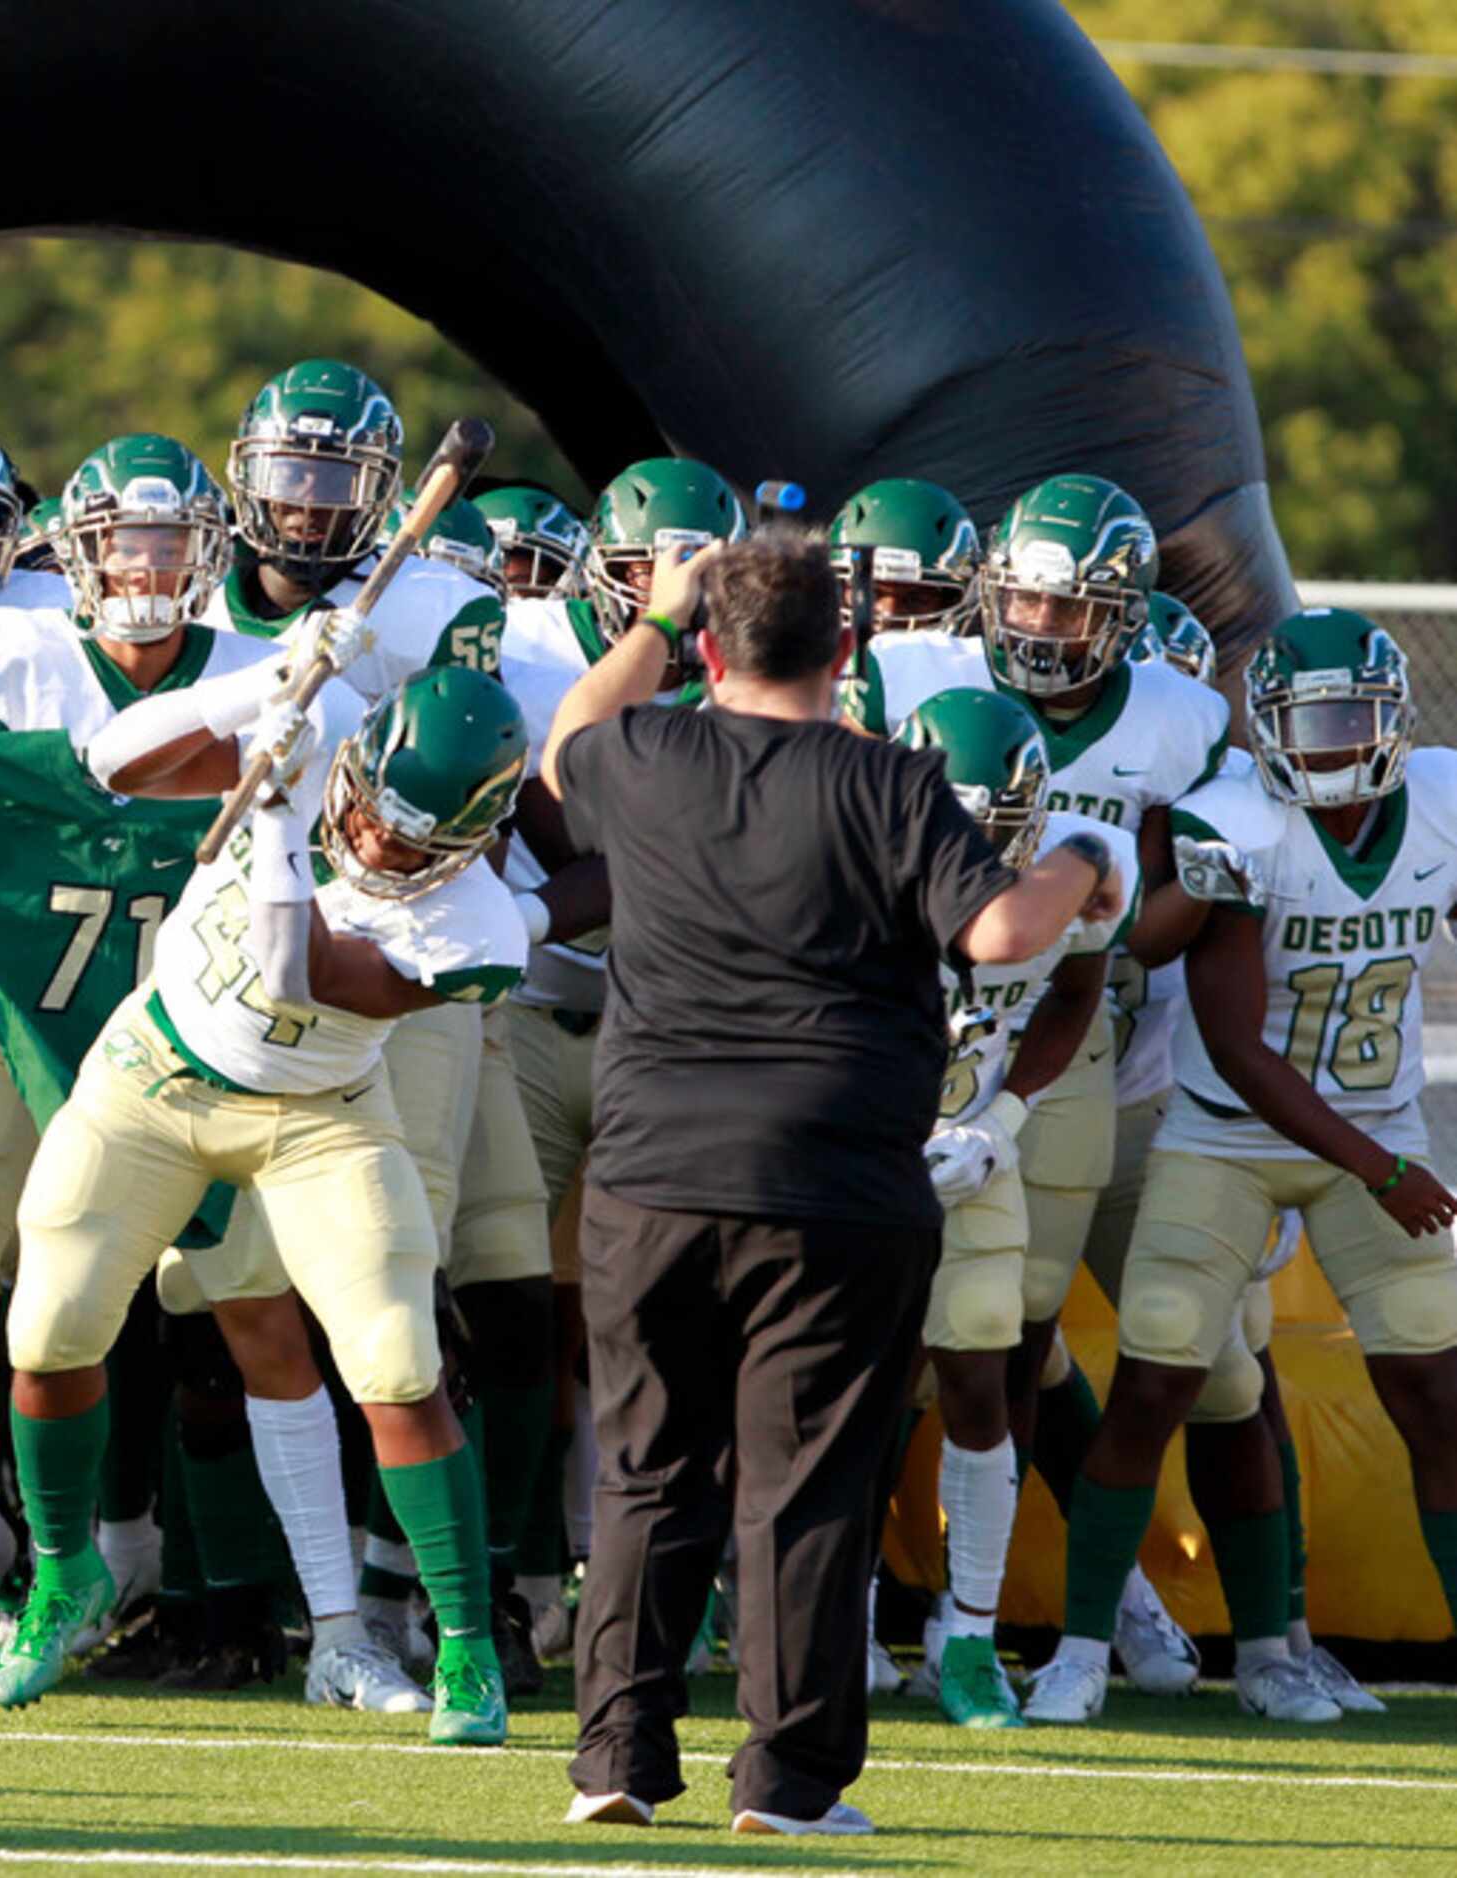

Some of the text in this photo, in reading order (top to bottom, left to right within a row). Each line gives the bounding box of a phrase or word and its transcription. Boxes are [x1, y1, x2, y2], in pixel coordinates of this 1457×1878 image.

[38, 880, 170, 1014] 71
[1281, 905, 1437, 954] DESOTO
[1279, 952, 1419, 1092] 18
